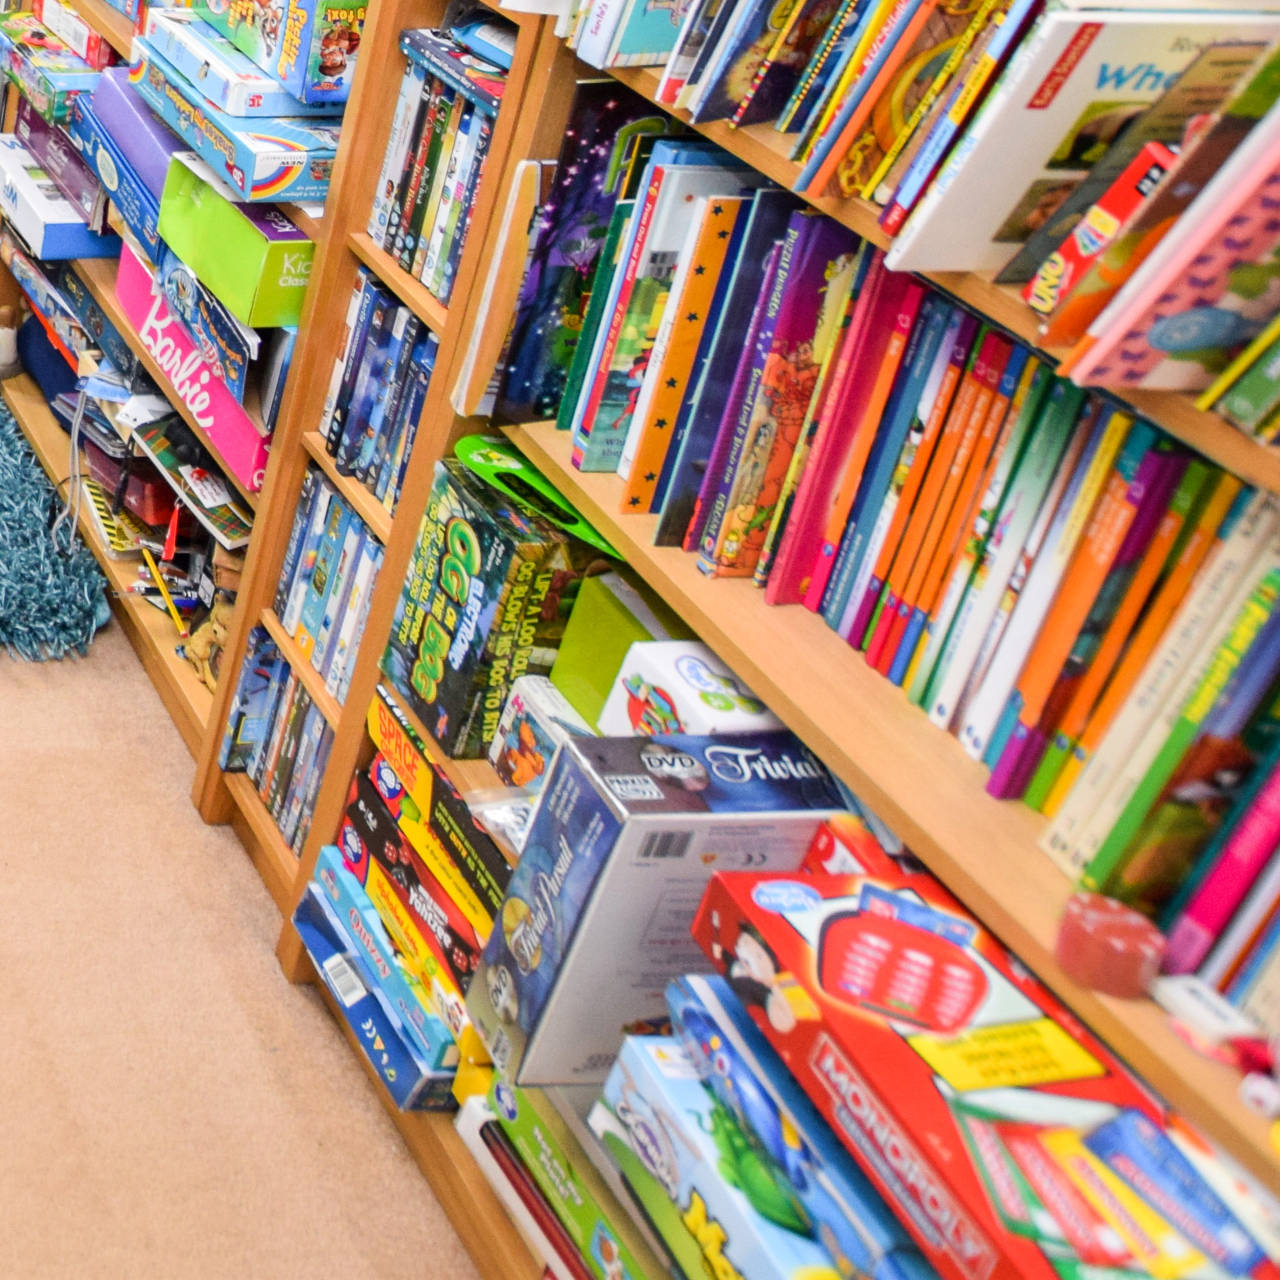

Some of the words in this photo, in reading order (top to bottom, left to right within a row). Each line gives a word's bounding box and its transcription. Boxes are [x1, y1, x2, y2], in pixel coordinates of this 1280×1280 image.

[588, 0, 608, 36] Santa's
[779, 228, 799, 269] PUZZLE
[1025, 249, 1071, 316] UNO
[139, 282, 215, 429] Barbie
[439, 516, 482, 607] OG
[500, 584, 528, 635] BLOWS
[518, 617, 539, 648] LOO
[410, 613, 453, 705] BOG
[495, 635, 514, 659] HIS
[378, 704, 420, 775] SPACE
[644, 754, 697, 770] DVD
[704, 745, 826, 783] Trivial
[499, 903, 552, 977] Trivial
[534, 832, 580, 919] Pursuit
[821, 1055, 983, 1262] MONOPOLY
